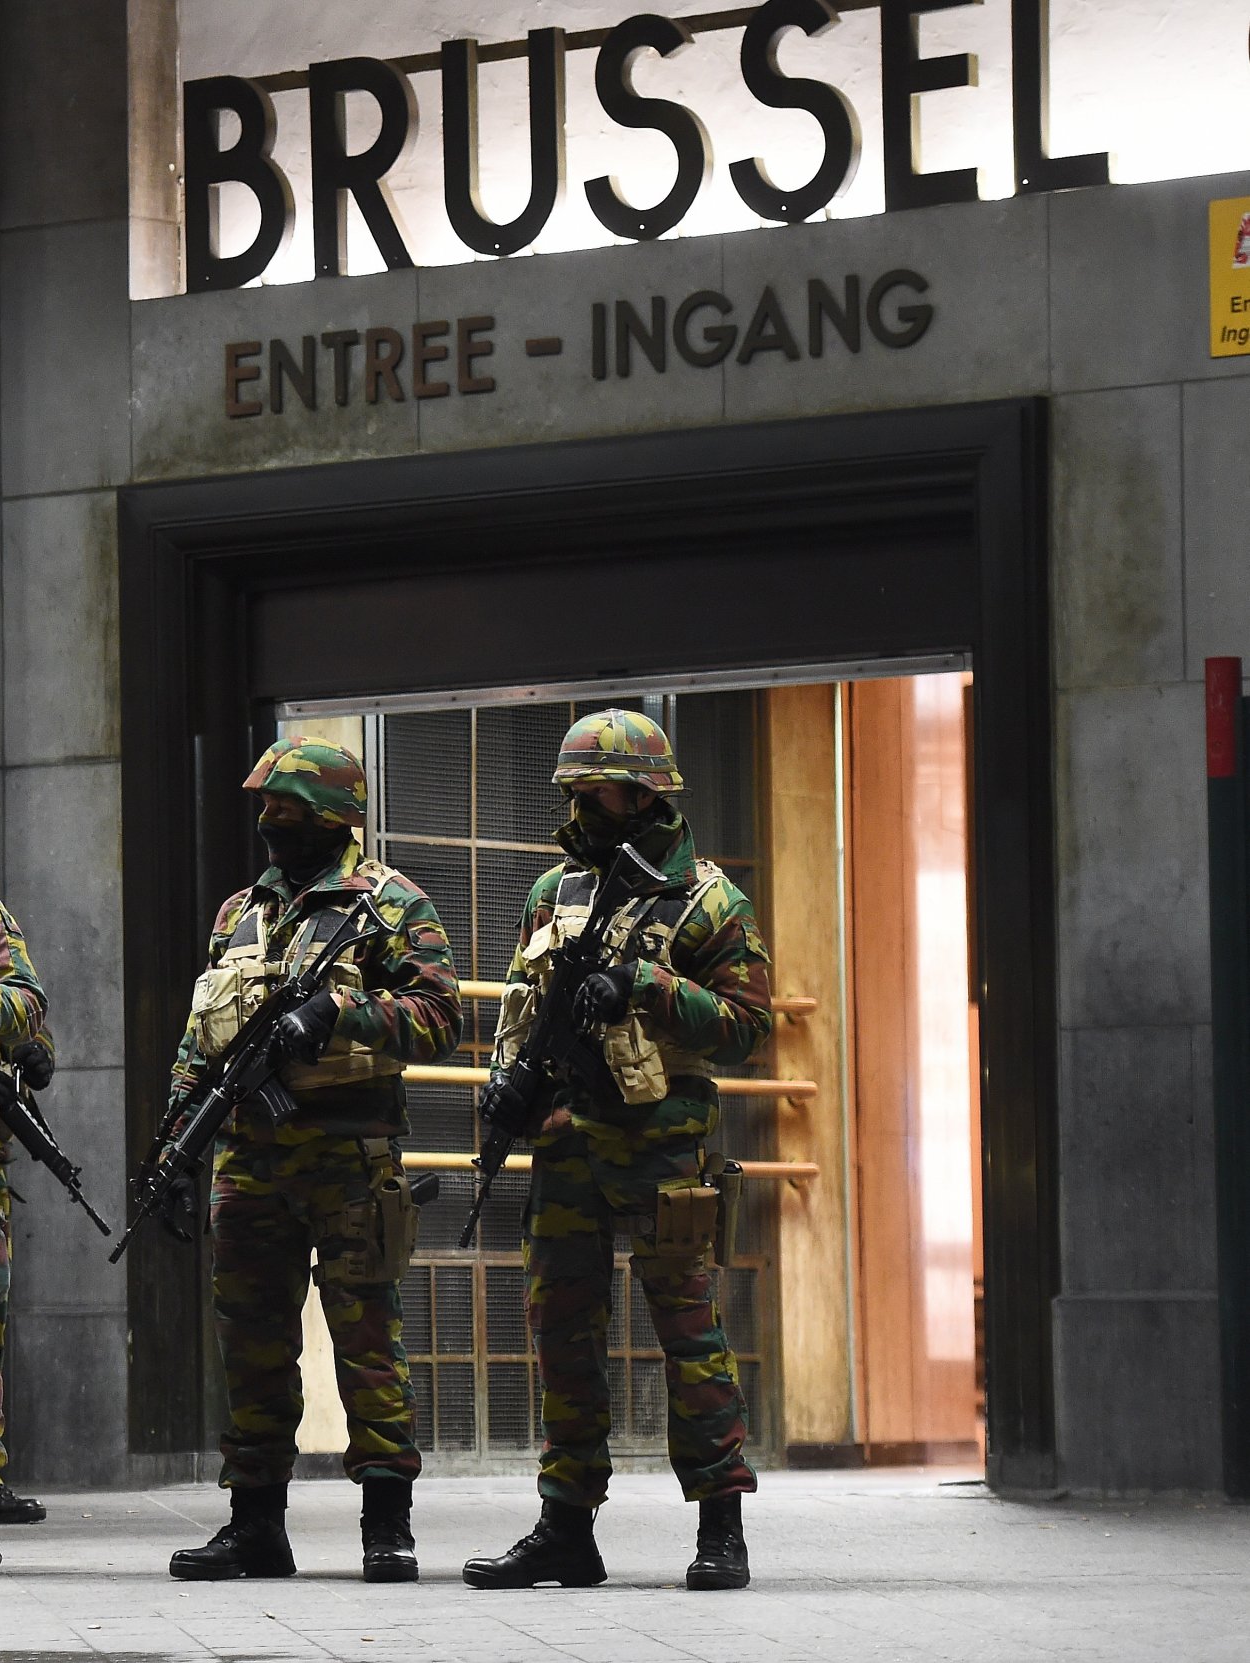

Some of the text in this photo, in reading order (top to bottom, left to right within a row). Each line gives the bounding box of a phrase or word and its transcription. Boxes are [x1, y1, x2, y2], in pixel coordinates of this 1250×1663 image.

[183, 0, 1116, 293] BRUSSEL
[224, 315, 496, 419] ENTREE
[592, 268, 934, 380] INGANG
